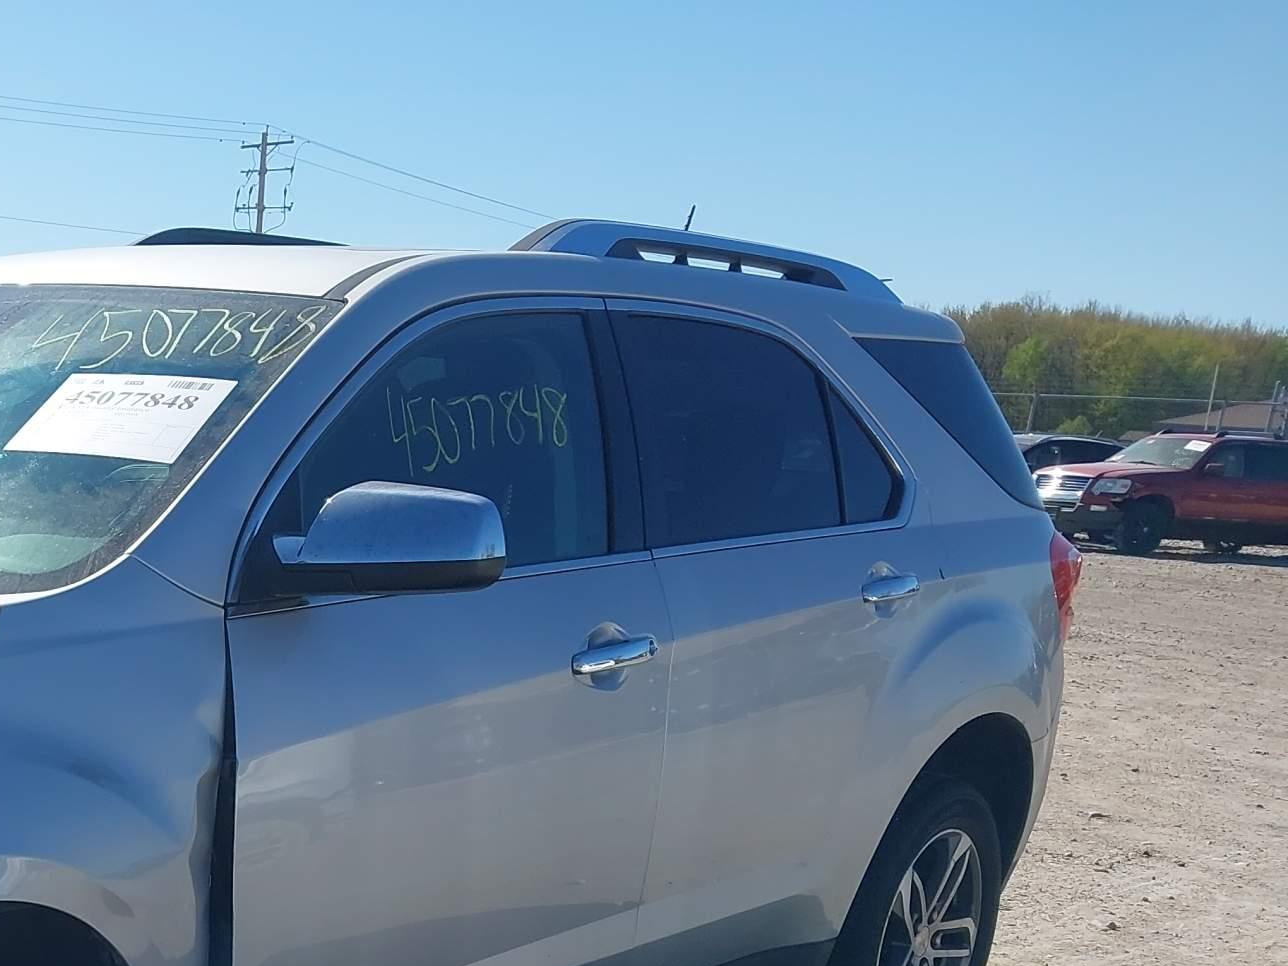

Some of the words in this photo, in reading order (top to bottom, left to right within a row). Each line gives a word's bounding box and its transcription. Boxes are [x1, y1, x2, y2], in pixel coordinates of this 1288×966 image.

[31, 304, 328, 372] 45077848
[65, 389, 200, 412] 45077848
[386, 383, 568, 478] 45077848
